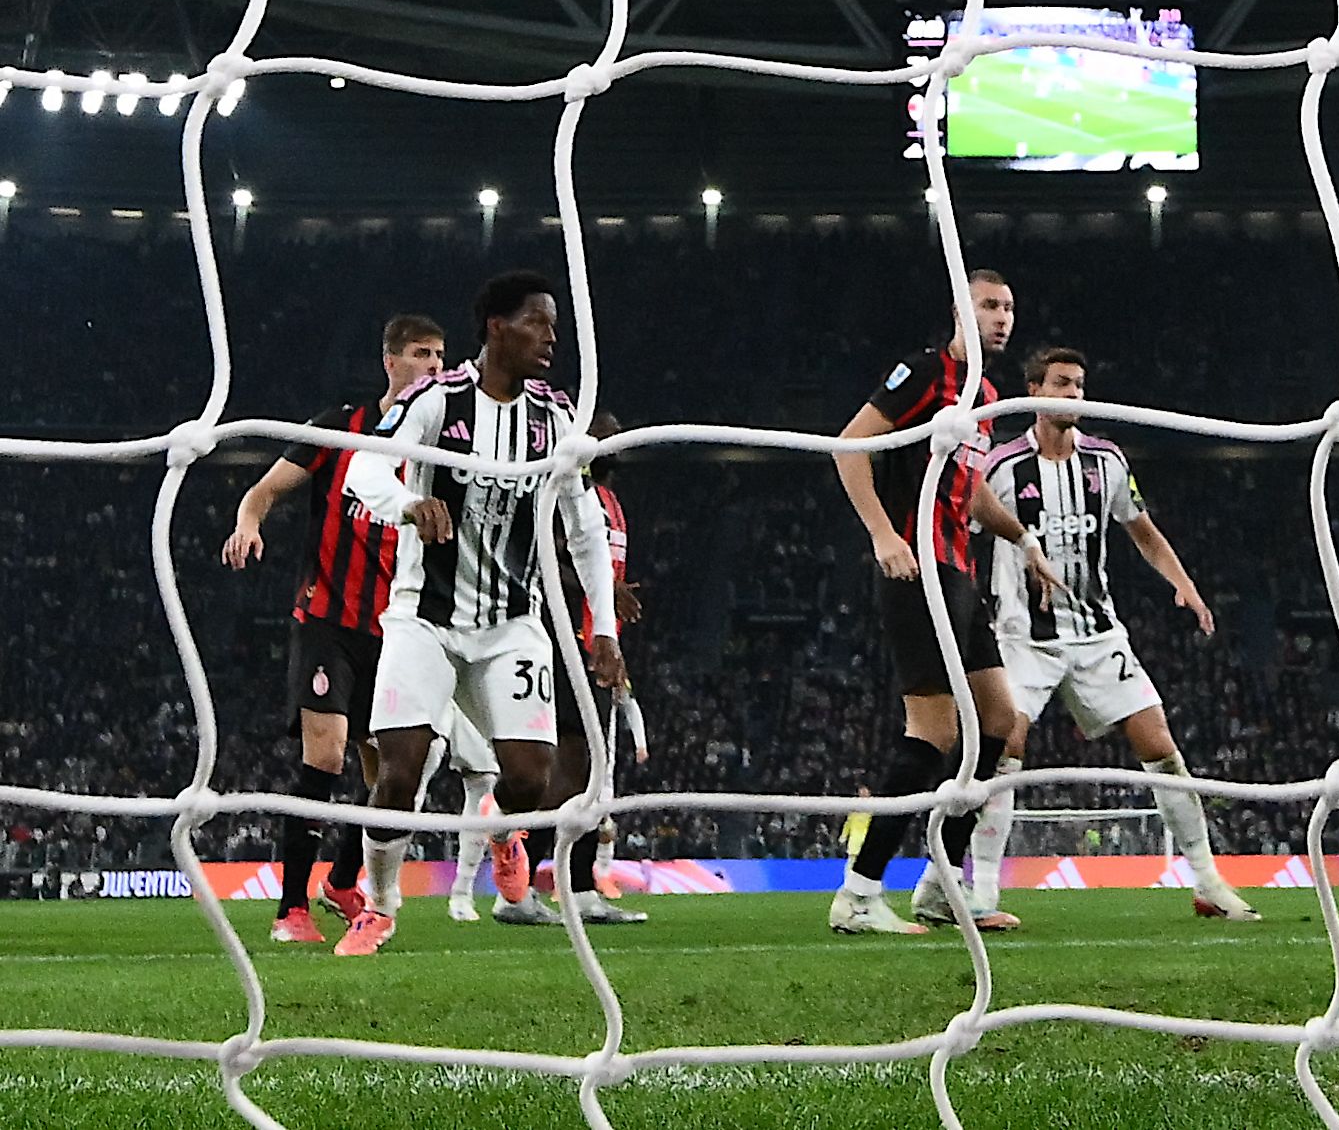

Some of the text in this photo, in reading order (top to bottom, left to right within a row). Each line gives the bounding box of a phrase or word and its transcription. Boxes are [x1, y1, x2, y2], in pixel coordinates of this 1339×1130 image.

[1028, 510, 1097, 538] Jeep
[512, 660, 551, 704] 30
[99, 870, 192, 897] JUVENTUS
